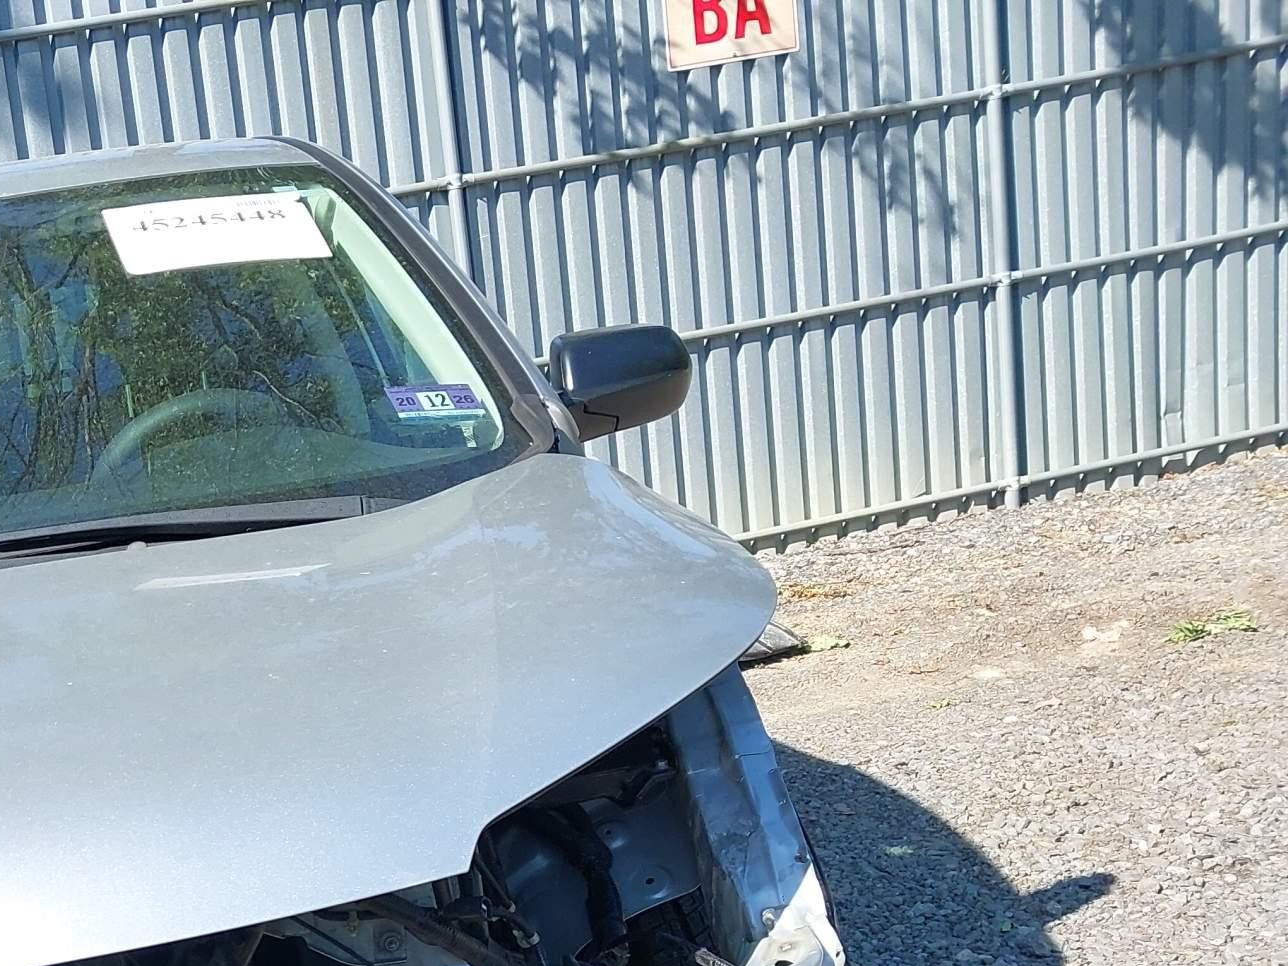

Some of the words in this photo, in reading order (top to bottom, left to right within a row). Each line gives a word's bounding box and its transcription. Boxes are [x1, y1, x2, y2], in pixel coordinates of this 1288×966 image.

[691, 0, 772, 45] BA
[133, 210, 286, 231] 45245448
[395, 396, 417, 407] 20
[424, 393, 450, 408] 12
[452, 394, 475, 404] 26
